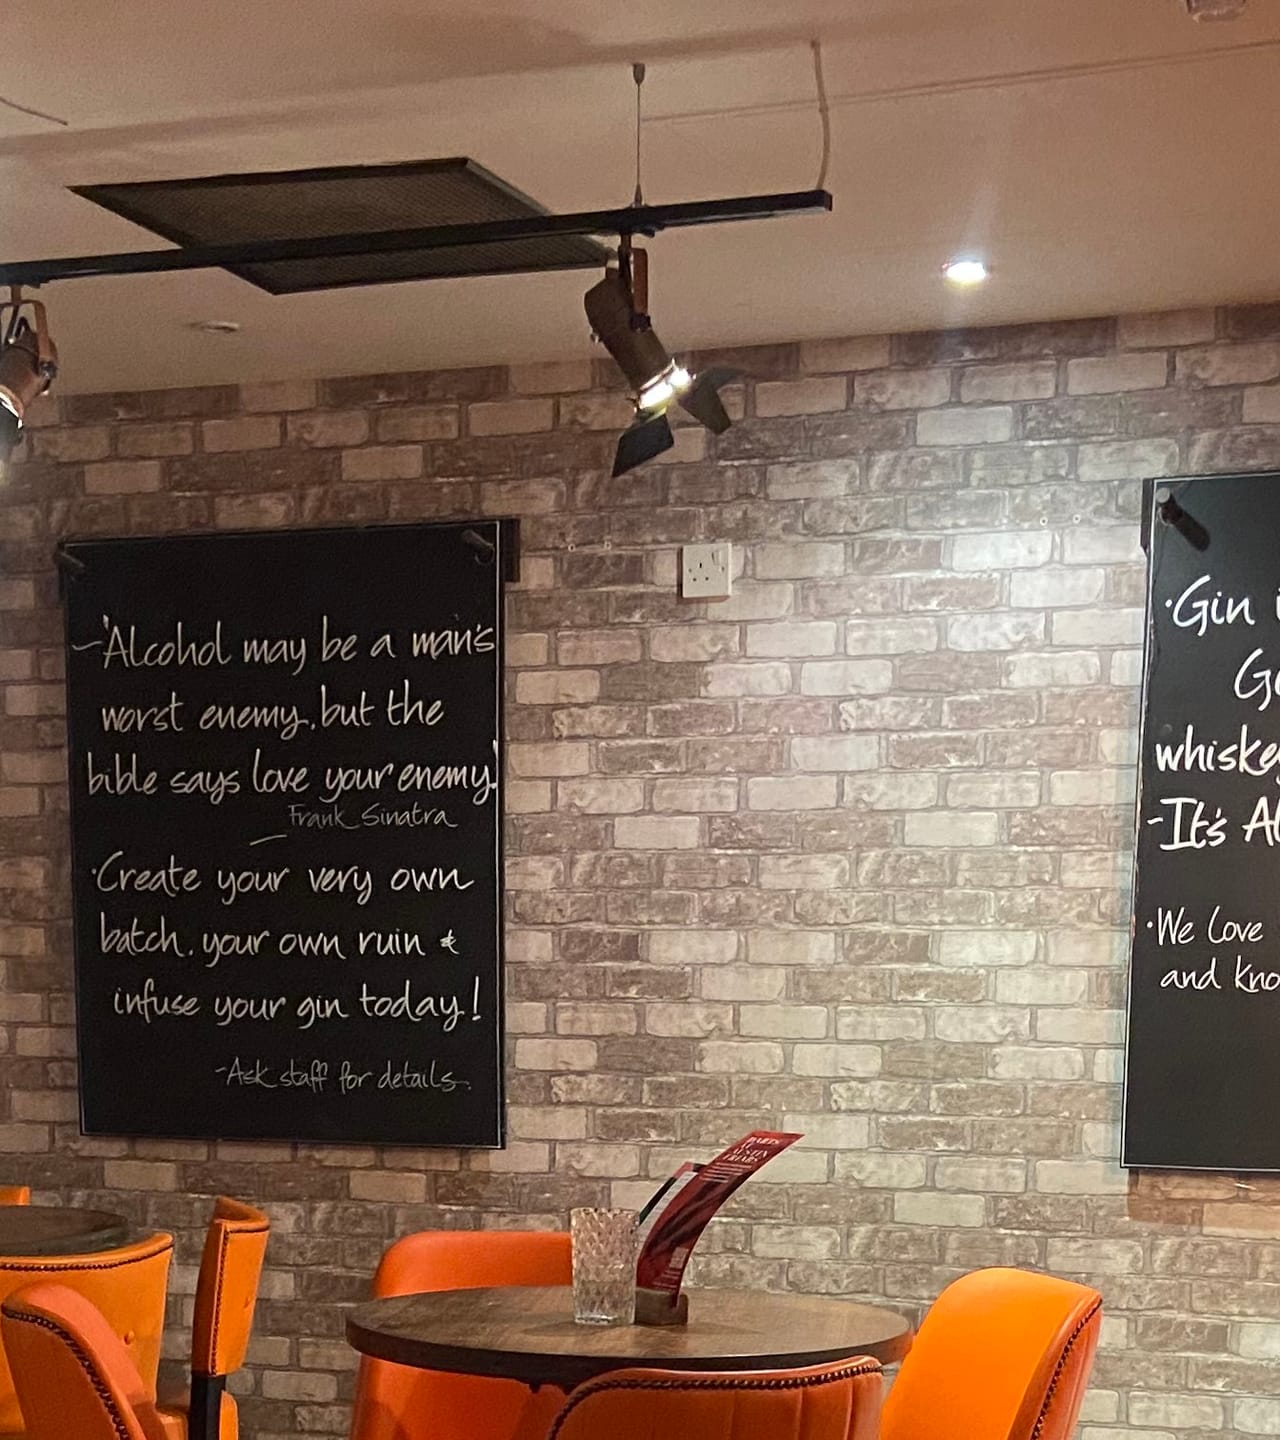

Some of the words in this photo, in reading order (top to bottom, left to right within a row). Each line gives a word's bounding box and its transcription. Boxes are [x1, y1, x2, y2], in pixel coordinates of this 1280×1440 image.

[1171, 573, 1256, 637] Gin
[243, 634, 306, 676] may
[321, 615, 357, 664] be
[370, 634, 396, 659] a
[412, 623, 497, 661] man's
[101, 690, 185, 733] worst
[320, 684, 375, 727] but
[386, 679, 445, 727] the
[87, 751, 158, 796] bible
[169, 769, 241, 805] says
[252, 748, 310, 794] love
[318, 762, 394, 803] your
[287, 803, 357, 829] Frank
[361, 801, 459, 828] Sinatra
[96, 851, 201, 898] Create
[217, 867, 290, 905] your
[308, 865, 373, 905] very
[390, 866, 476, 892] own
[202, 930, 270, 968] your
[279, 933, 348, 960] own
[359, 927, 426, 957] ruin
[1157, 907, 1196, 946] We
[1207, 905, 1265, 944] love
[1160, 957, 1222, 990] and
[113, 978, 201, 1024] infuse
[214, 996, 287, 1027] your
[298, 995, 350, 1030] gin
[279, 1058, 328, 1092] staff
[338, 1059, 373, 1093] for
